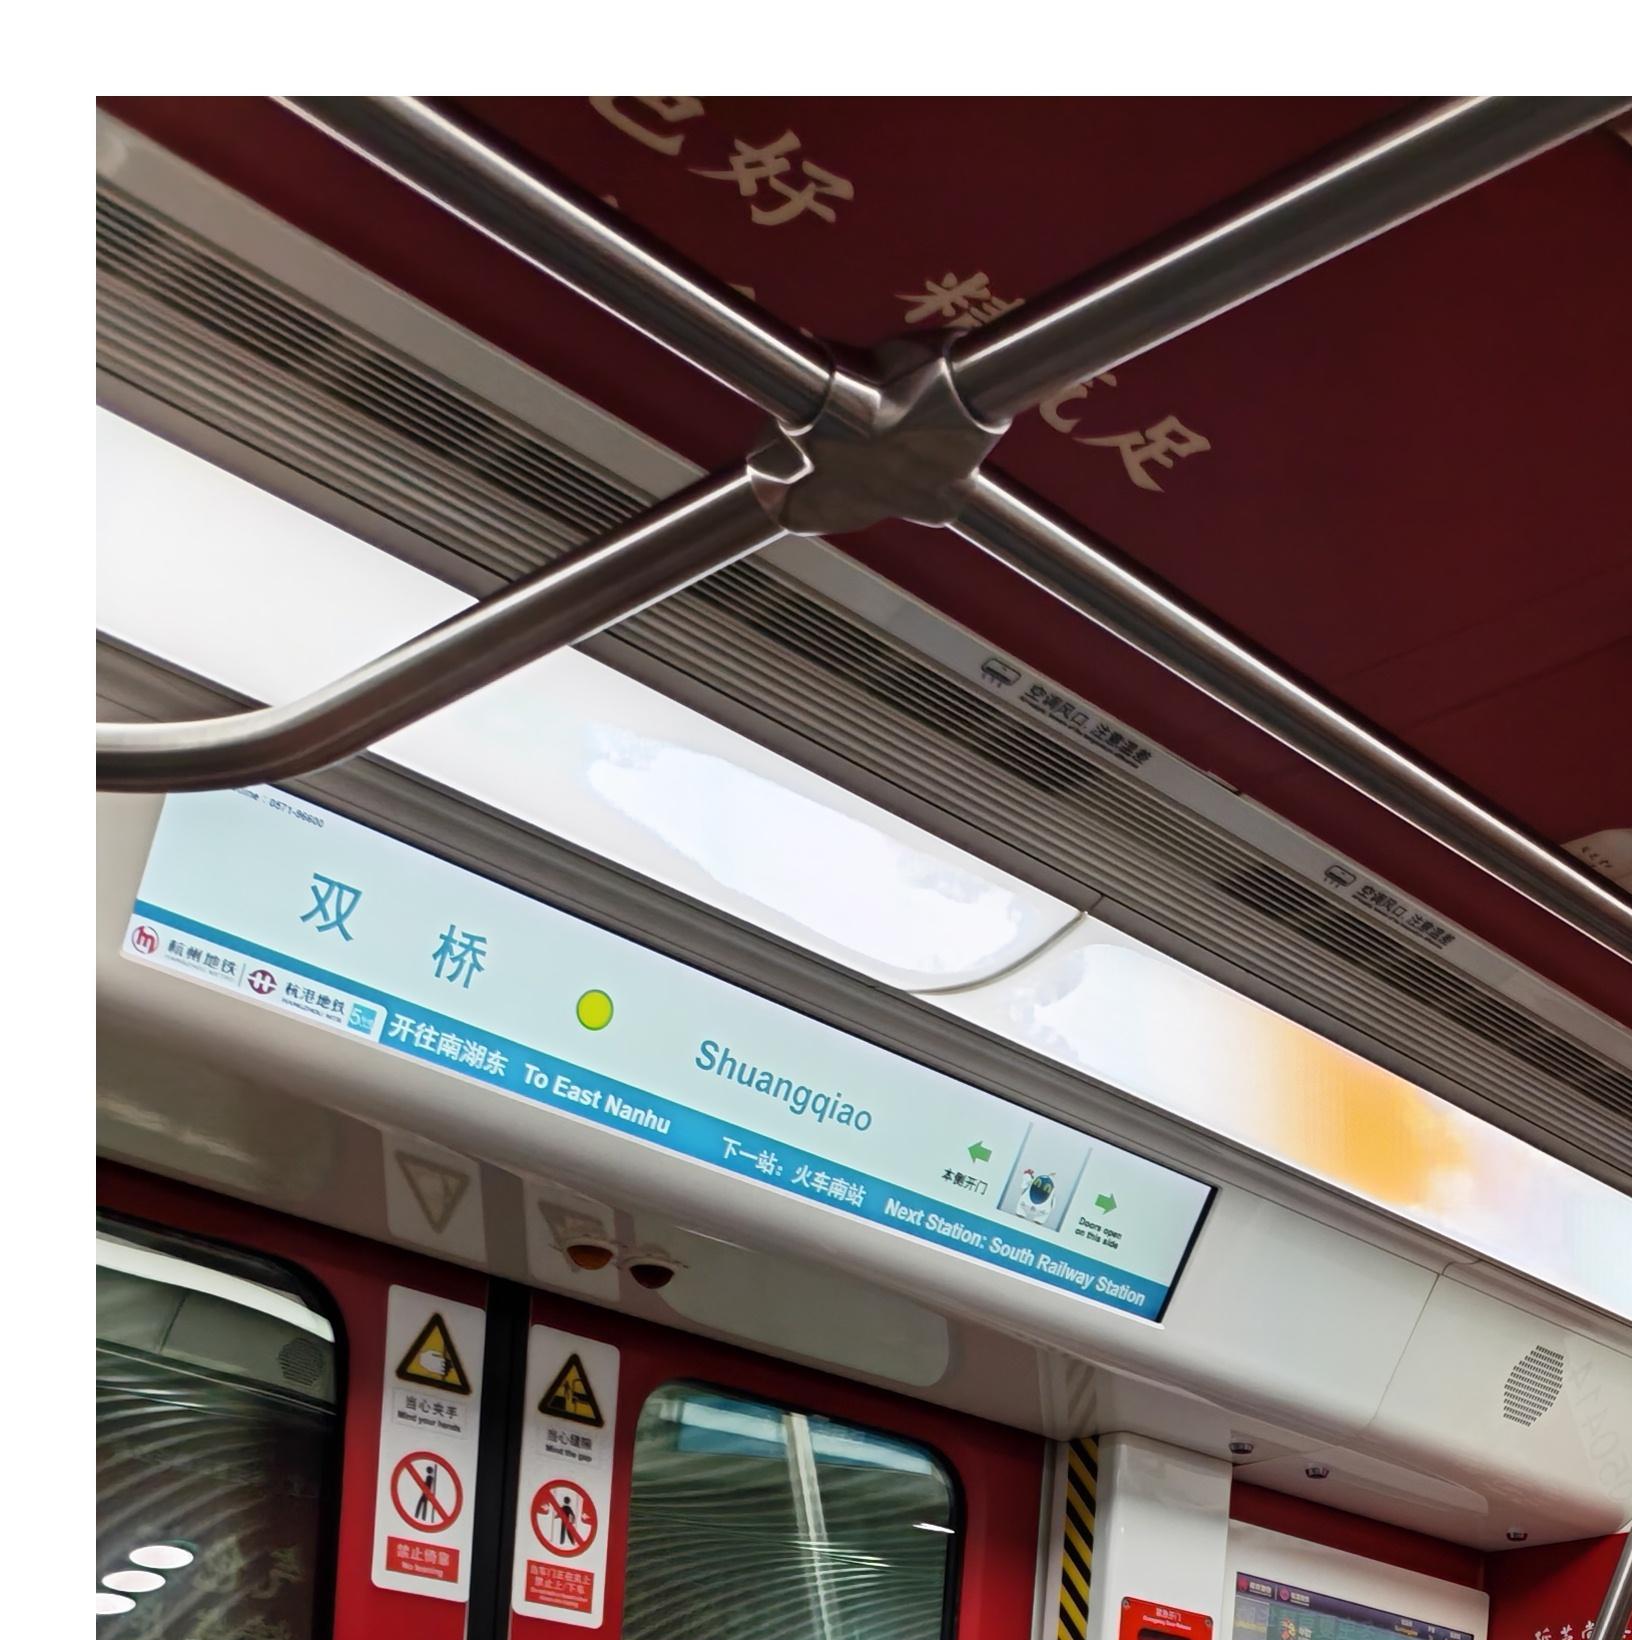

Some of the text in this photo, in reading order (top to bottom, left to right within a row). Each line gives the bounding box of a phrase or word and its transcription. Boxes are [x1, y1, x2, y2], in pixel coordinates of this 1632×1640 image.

[168, 939, 237, 977] 杭州地铁
[388, 1012, 508, 1077] 开往南湖东
[523, 1062, 672, 1135] To East Nanhu
[695, 1039, 874, 1132] Shuangqiao
[884, 1197, 1146, 1308] Next Station: South Railway Station
[1078, 1215, 1123, 1241] Doors open
[1086, 1230, 1102, 1243] this
[1101, 1238, 1120, 1251] side
